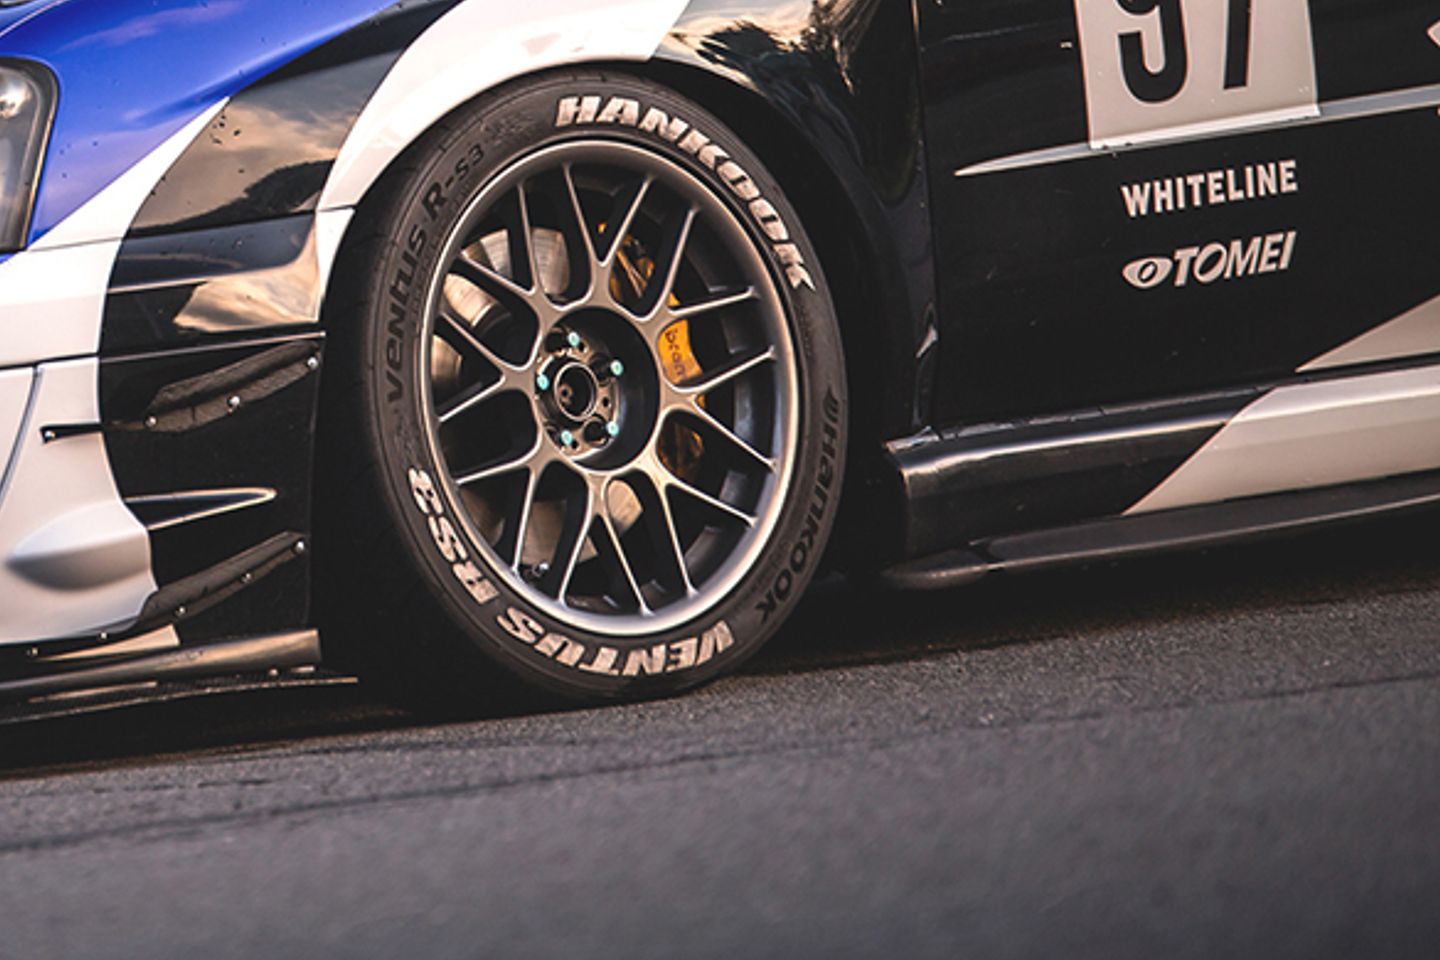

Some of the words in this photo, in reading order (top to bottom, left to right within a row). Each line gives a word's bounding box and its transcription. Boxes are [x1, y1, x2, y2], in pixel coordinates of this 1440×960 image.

[555, 94, 815, 292] HANKOOK
[1120, 160, 1298, 218] WHITELINE
[1173, 230, 1297, 287] TOMEI
[407, 467, 500, 604] RS3
[496, 606, 735, 676] VENTUS
